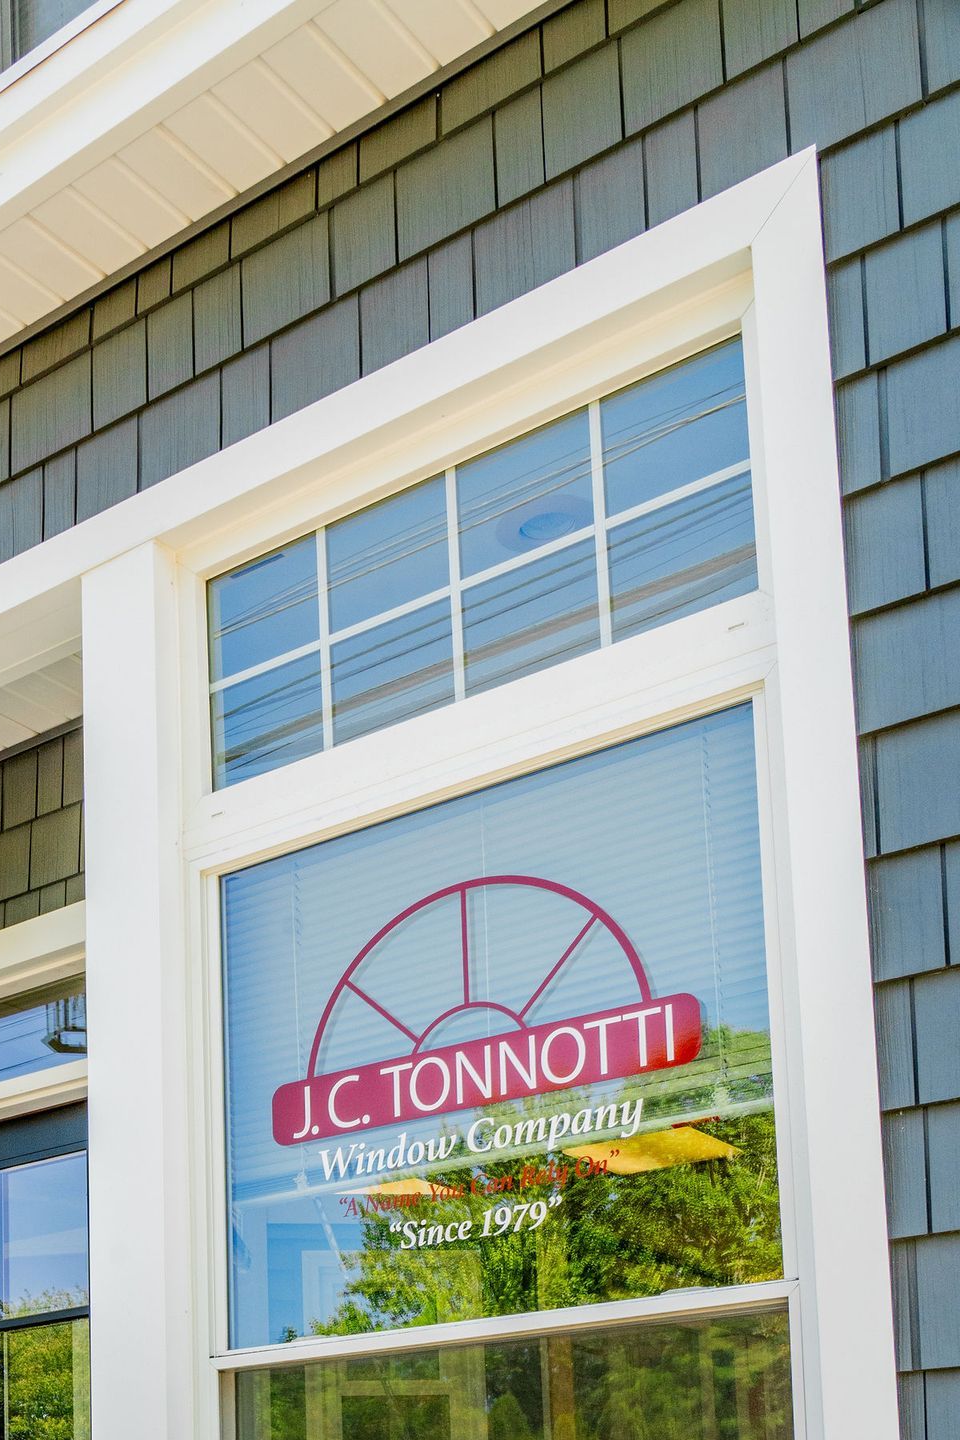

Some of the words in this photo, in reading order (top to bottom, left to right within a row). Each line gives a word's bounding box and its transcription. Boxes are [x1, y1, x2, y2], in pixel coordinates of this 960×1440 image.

[380, 1003, 675, 1118] TONNOTTI
[319, 1132, 457, 1181] Window
[467, 1098, 644, 1151] Company
[365, 1190, 422, 1216] Name
[429, 1182, 465, 1203] You
[471, 1172, 513, 1196] Can
[520, 1158, 568, 1189] Rely
